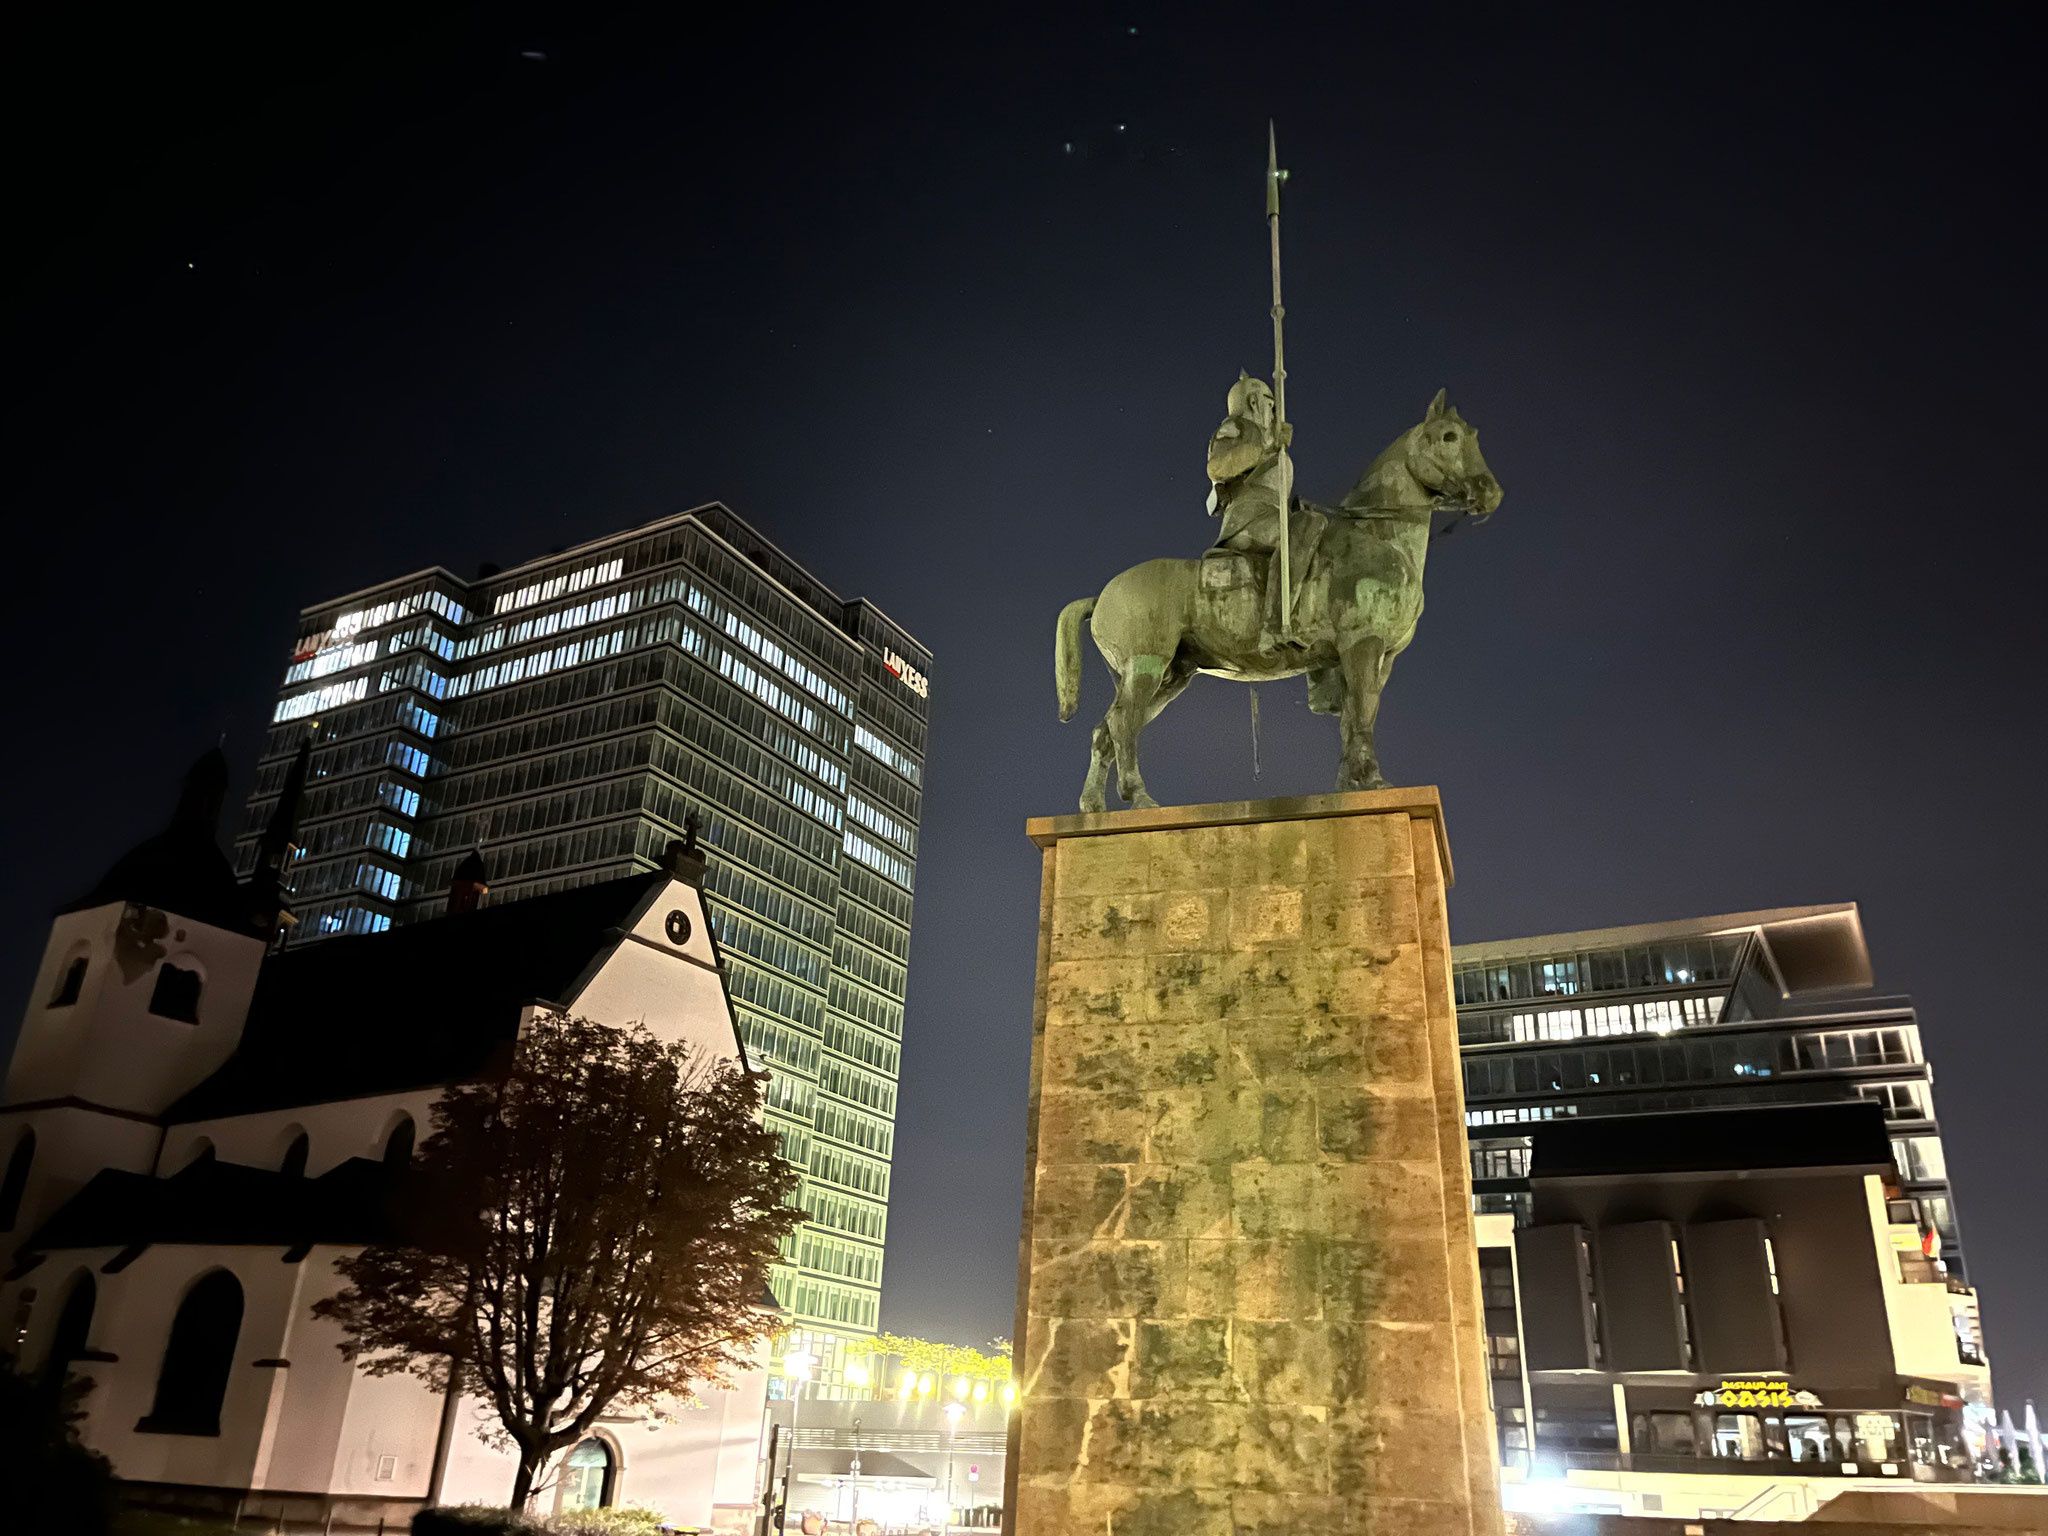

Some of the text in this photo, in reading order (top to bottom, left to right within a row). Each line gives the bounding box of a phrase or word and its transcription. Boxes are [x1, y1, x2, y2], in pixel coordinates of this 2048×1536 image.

[883, 646, 928, 699] LANXESS
[1721, 1381, 1788, 1390] RESTAURANT
[1720, 1390, 1793, 1408] OASIS
